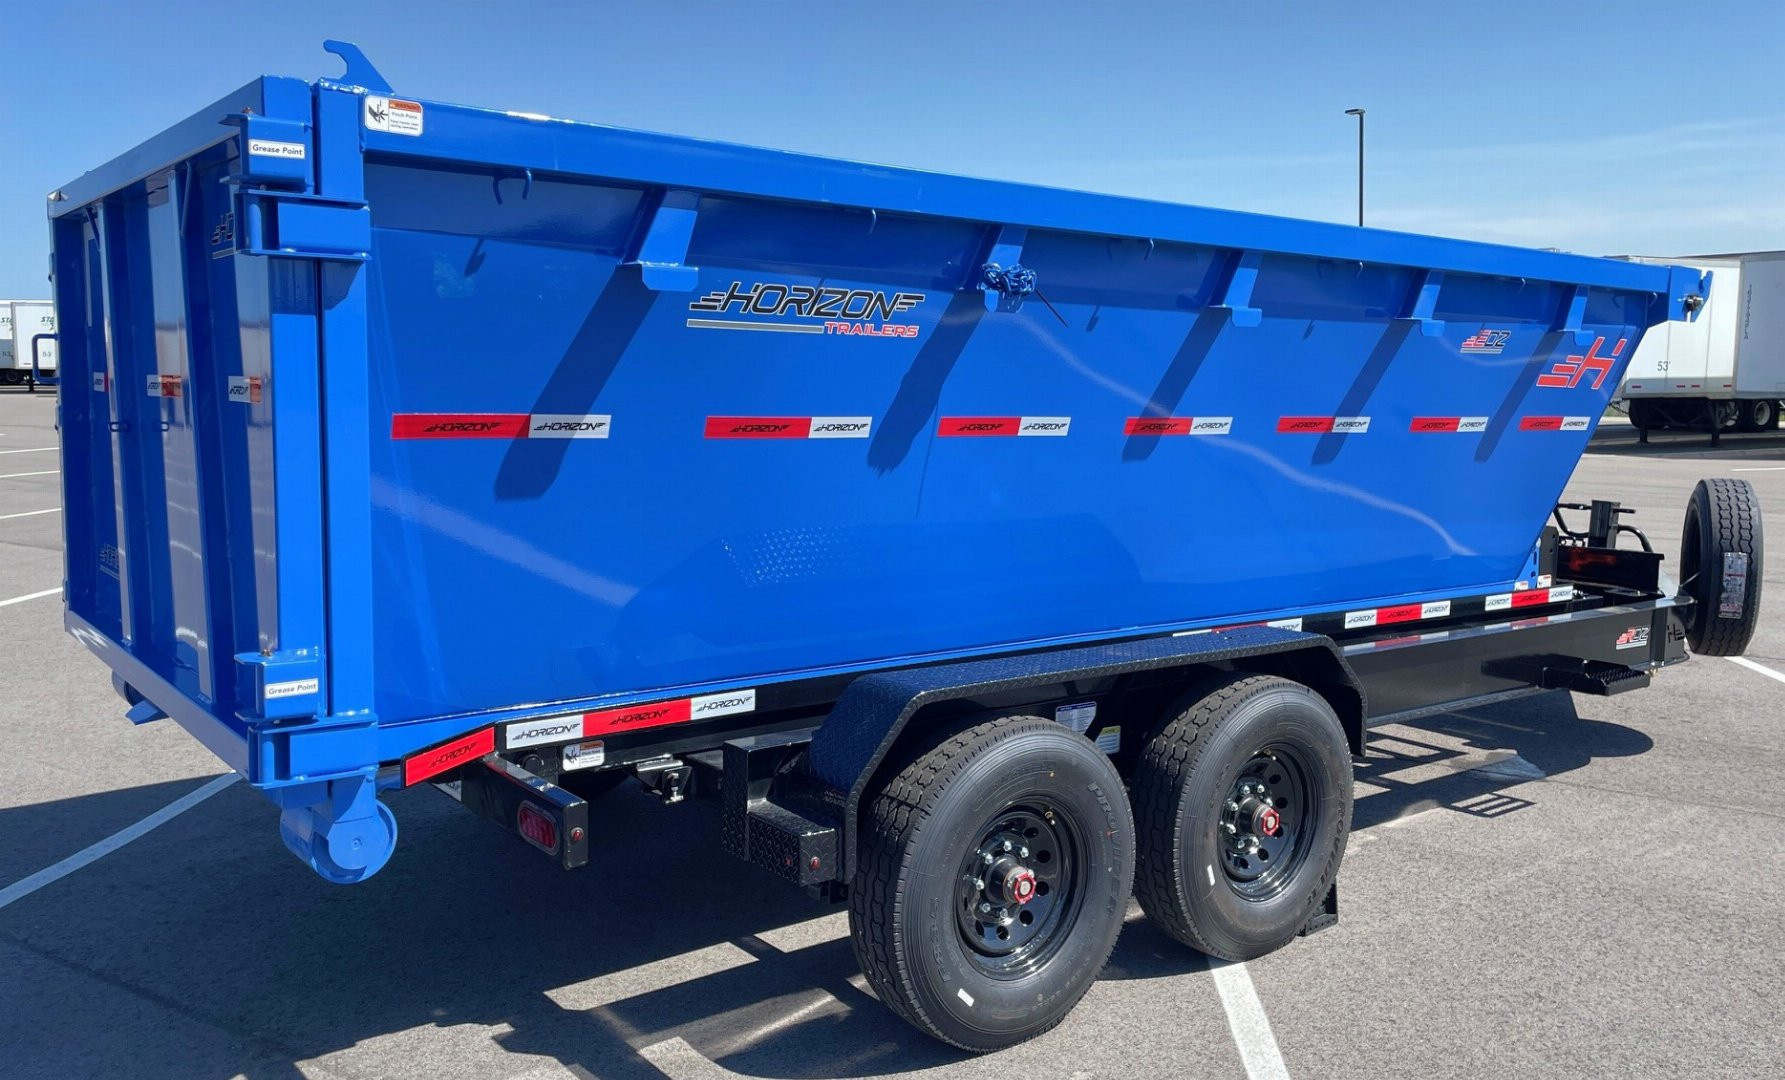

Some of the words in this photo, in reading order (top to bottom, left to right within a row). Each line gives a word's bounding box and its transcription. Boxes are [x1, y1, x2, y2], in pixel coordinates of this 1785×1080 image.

[252, 143, 280, 154] Grease
[282, 144, 303, 156] Point
[714, 281, 907, 321] HORIZON
[824, 321, 920, 338] TRAILERS
[428, 422, 499, 432] HORIZON
[538, 422, 602, 432] HORIZON
[733, 424, 787, 432] HORIZON
[817, 423, 866, 431] HORIZON
[961, 423, 1001, 431] HORIZON
[1025, 422, 1064, 431] HORIZON
[268, 685, 295, 695] Grease
[297, 683, 317, 692] Point
[517, 724, 576, 740] HORIZON
[613, 709, 667, 724] HORIZON
[699, 697, 750, 711] HORIZON
